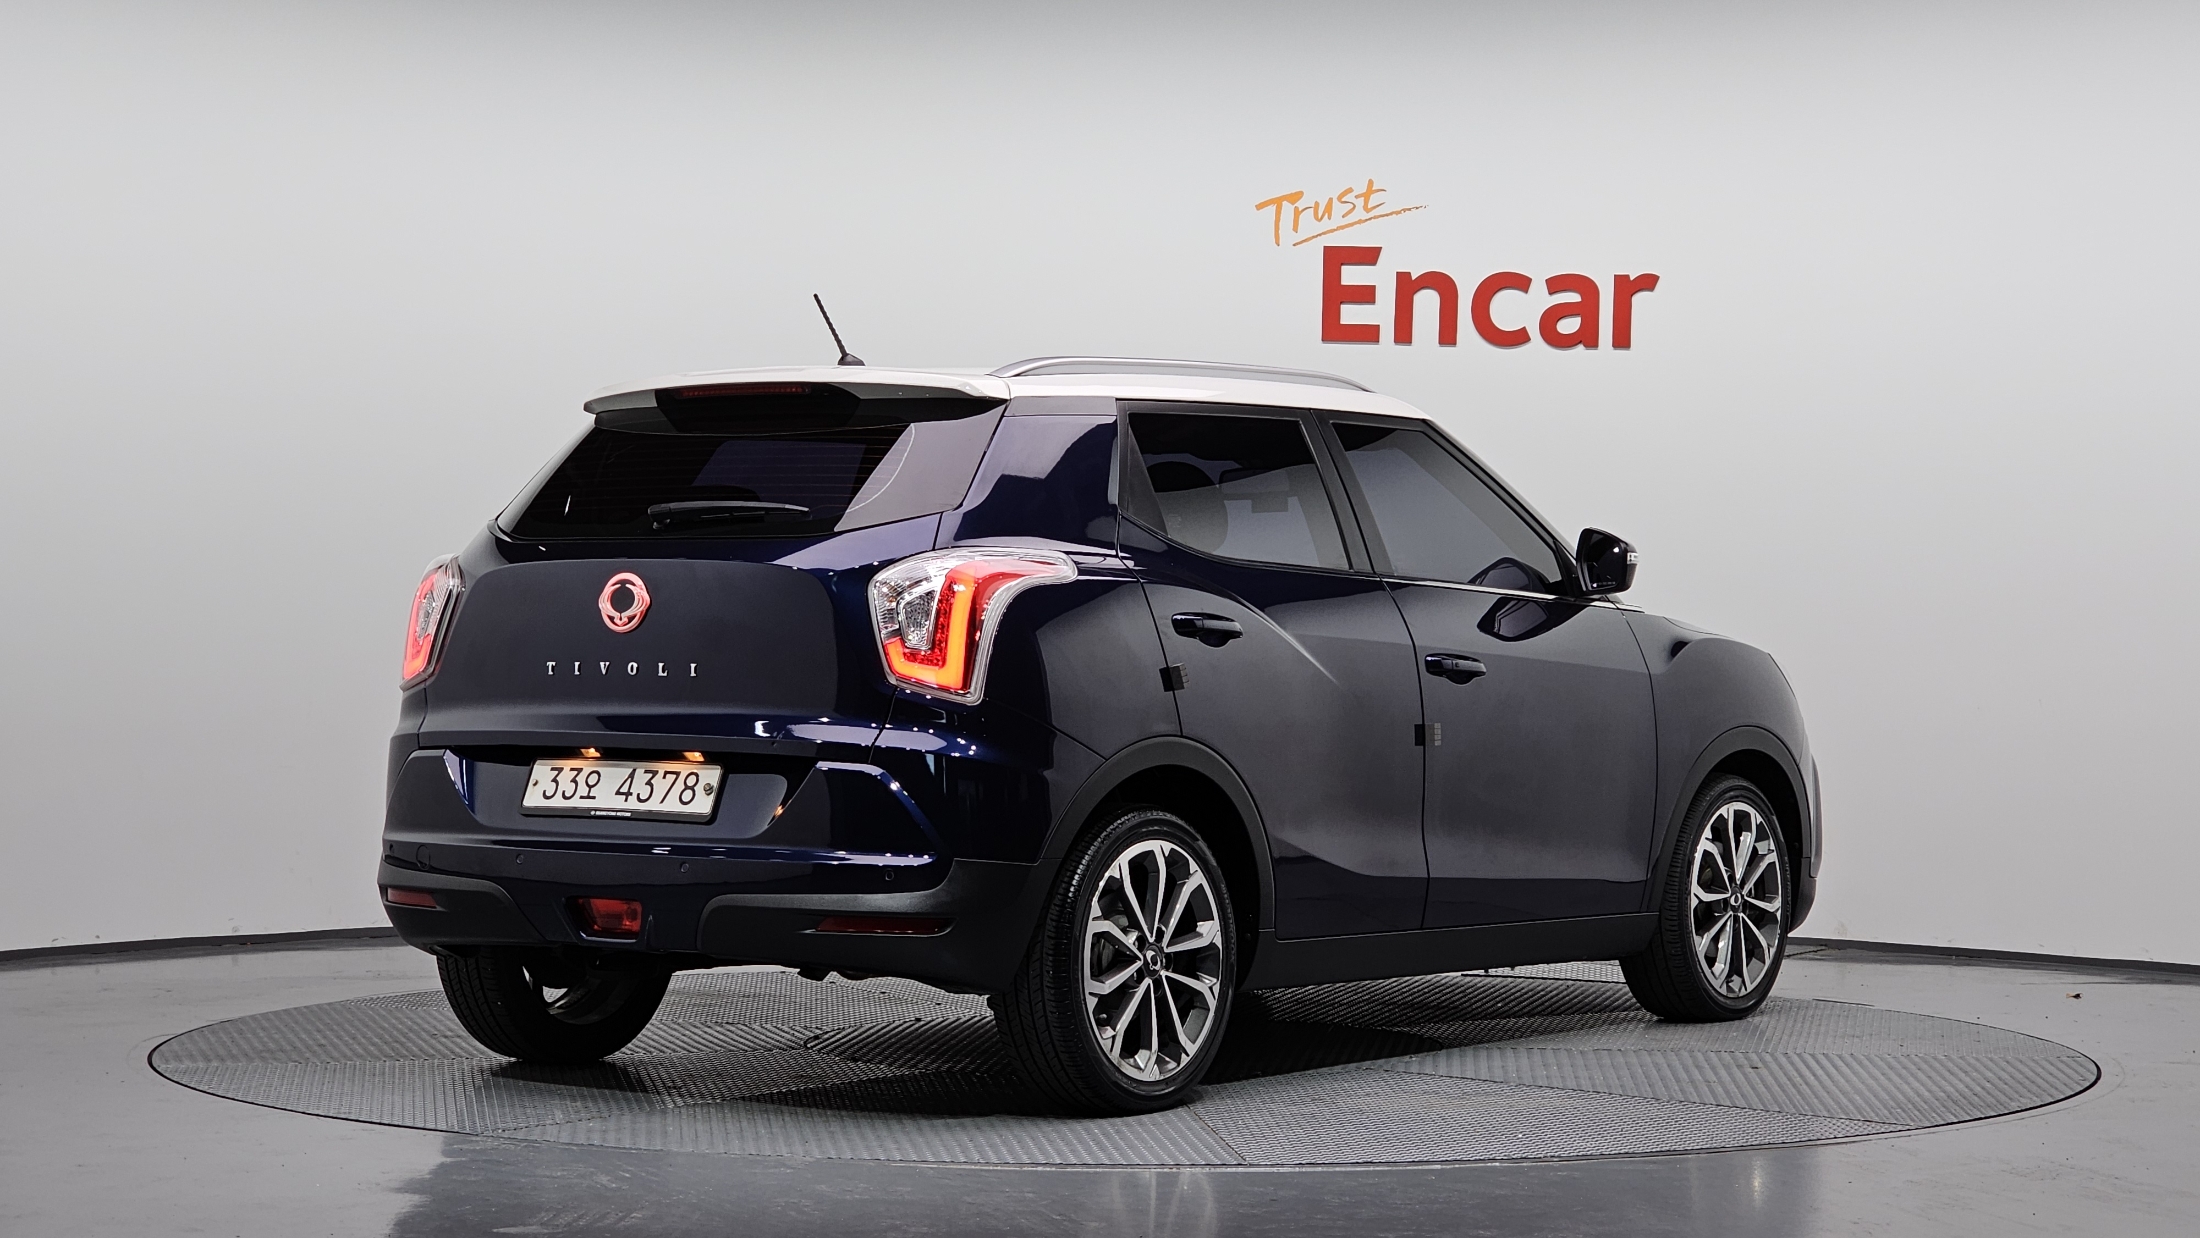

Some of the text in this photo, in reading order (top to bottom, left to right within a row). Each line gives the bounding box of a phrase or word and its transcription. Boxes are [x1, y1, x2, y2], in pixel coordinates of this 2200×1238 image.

[1255, 178, 1388, 247] Trust
[1321, 245, 1660, 350] Encar
[546, 661, 698, 677] TIVOLI
[542, 766, 700, 806] 33오 4378
